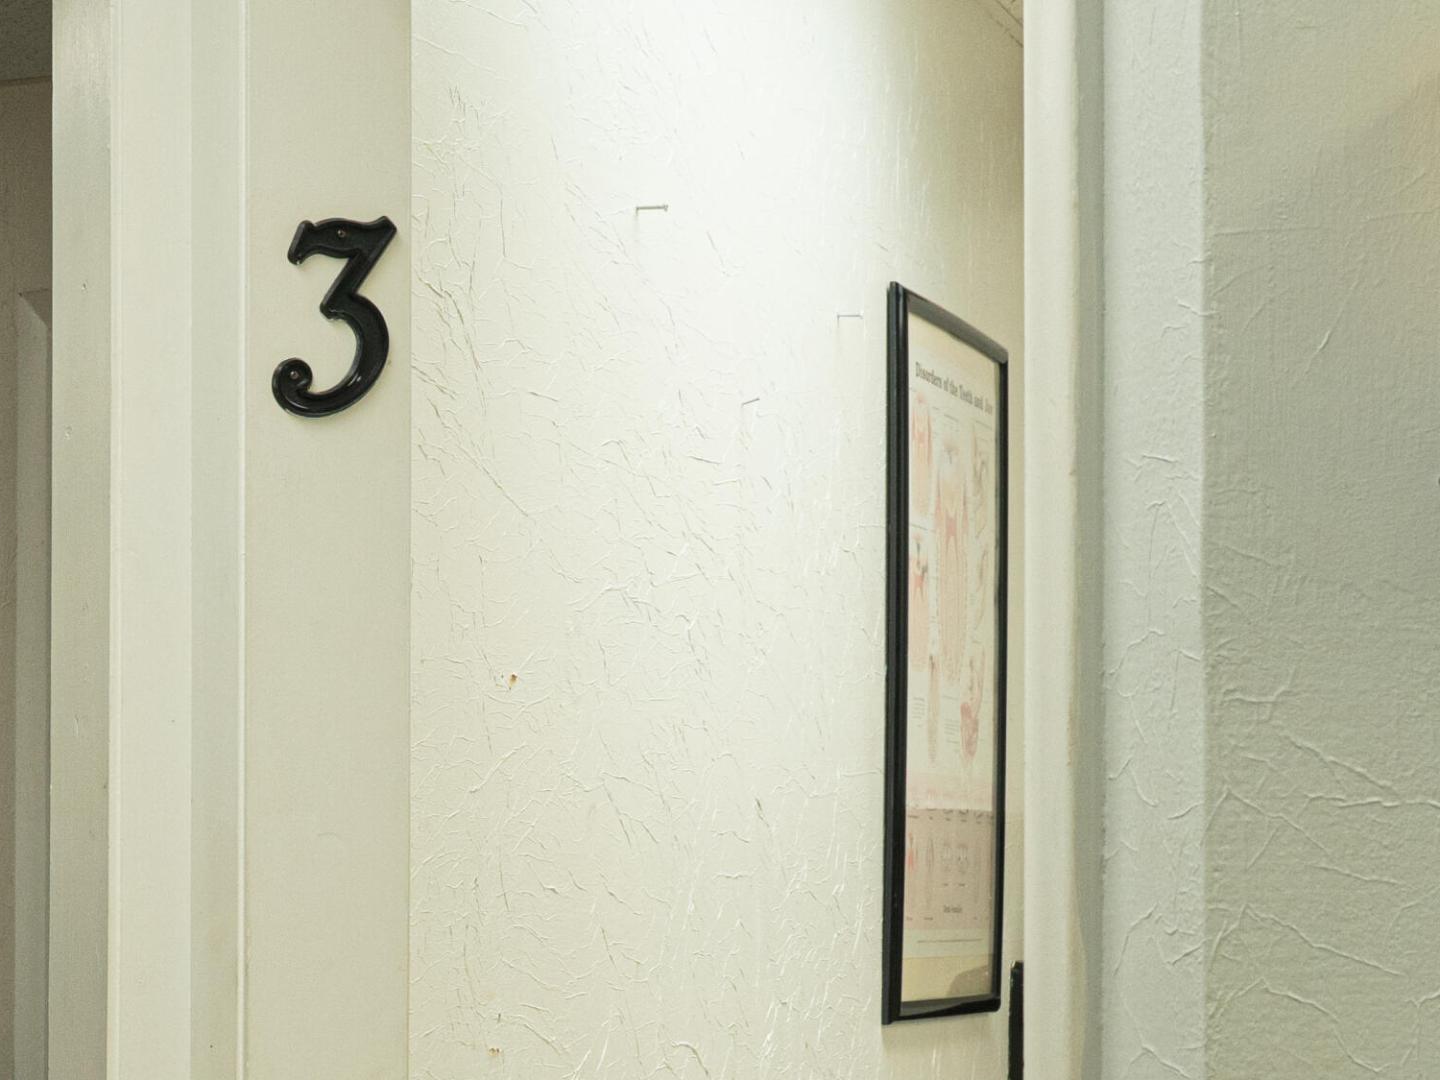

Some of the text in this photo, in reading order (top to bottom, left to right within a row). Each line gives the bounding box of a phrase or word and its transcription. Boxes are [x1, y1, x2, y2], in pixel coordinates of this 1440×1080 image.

[271, 215, 398, 418] 3
[915, 360, 943, 389] Disorders
[949, 379, 958, 397] the
[959, 384, 973, 405] Teeth
